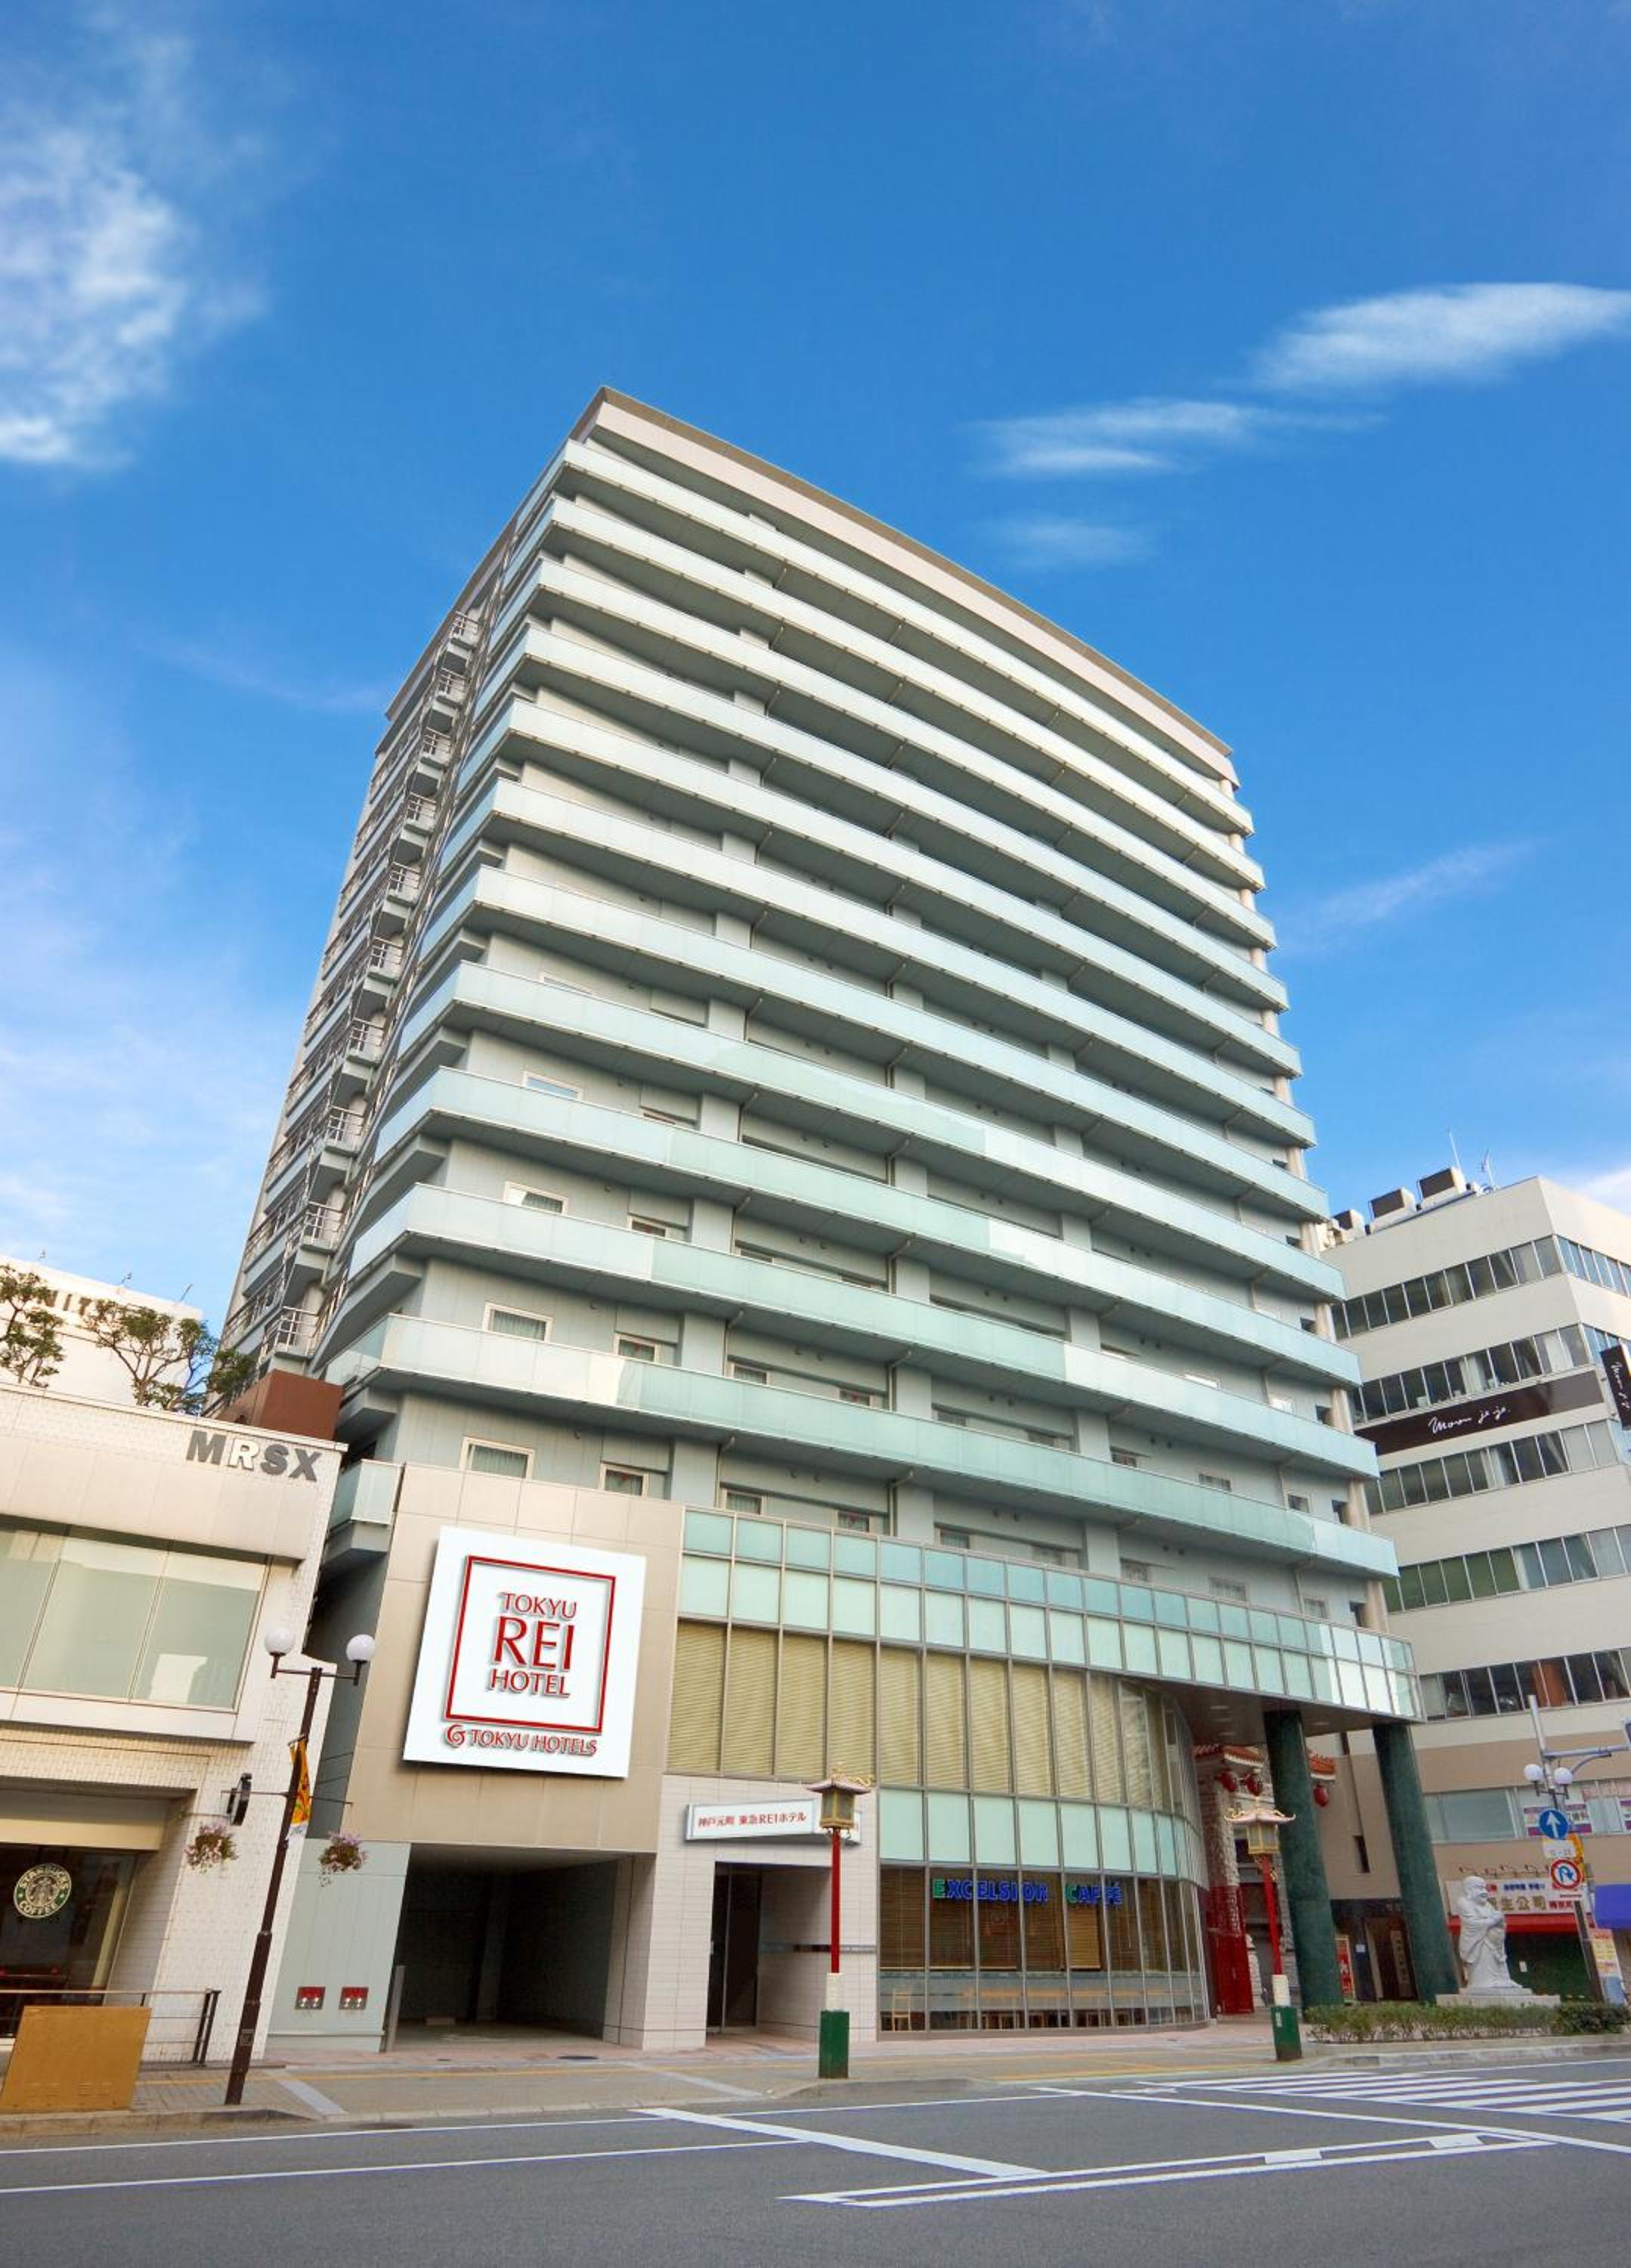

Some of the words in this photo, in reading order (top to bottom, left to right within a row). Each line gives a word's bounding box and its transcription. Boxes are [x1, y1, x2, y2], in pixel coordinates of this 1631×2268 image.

[186, 1430, 322, 1483] MRSX
[499, 1591, 577, 1619] TOKYU
[494, 1616, 575, 1670] REI
[491, 1668, 571, 1696] HOTEL
[471, 1728, 529, 1750] TOKYU
[532, 1734, 598, 1756] HOTELS
[932, 1878, 1049, 1903] EXCELSIOR
[19, 1900, 59, 1916] COFFEE
